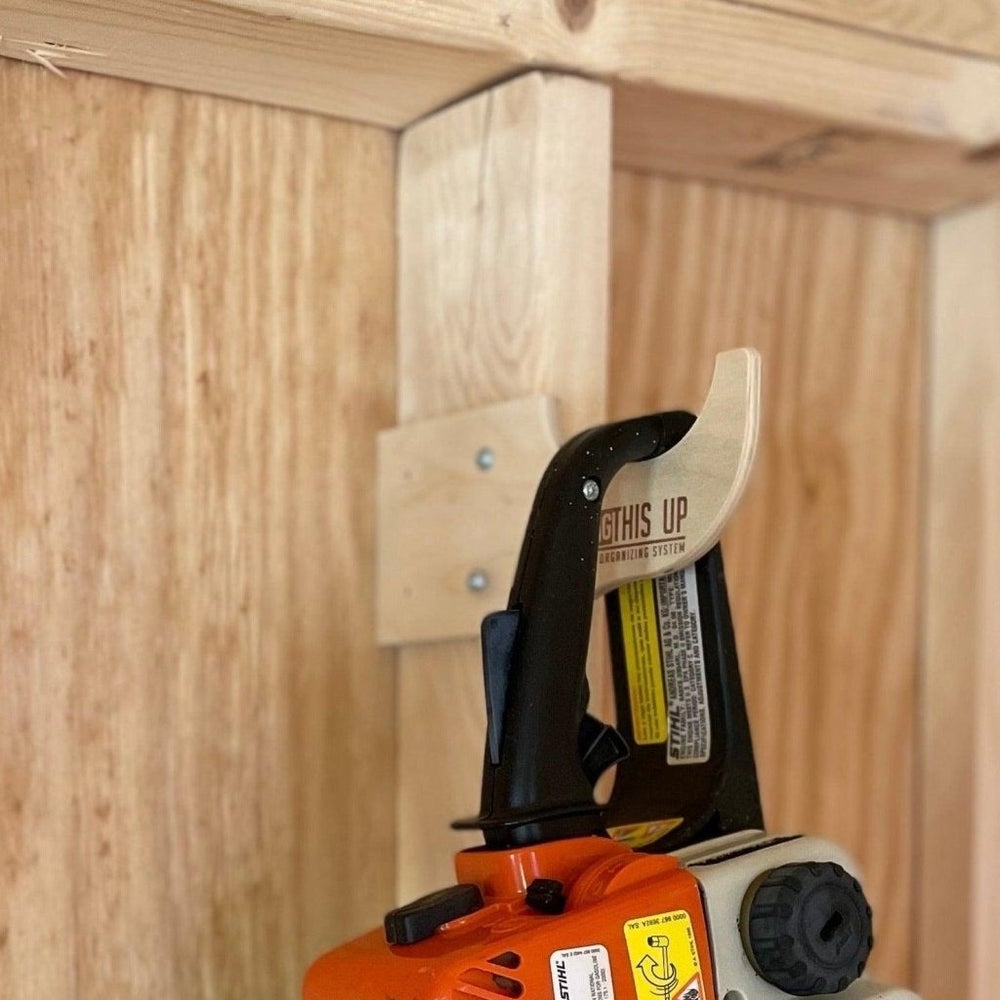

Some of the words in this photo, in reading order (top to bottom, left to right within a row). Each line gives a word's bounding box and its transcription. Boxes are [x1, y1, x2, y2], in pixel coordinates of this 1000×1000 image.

[663, 496, 688, 534] UP
[599, 547, 649, 564] ORGANIZING
[653, 542, 686, 557] SYSTEM
[665, 649, 674, 667] STIHL
[667, 669, 676, 698] ANDREAS
[669, 706, 680, 758] STIHL
[555, 960, 569, 1000] STIHL
[591, 955, 599, 979] GASOLINE
[588, 972, 596, 996] NATIONAL
